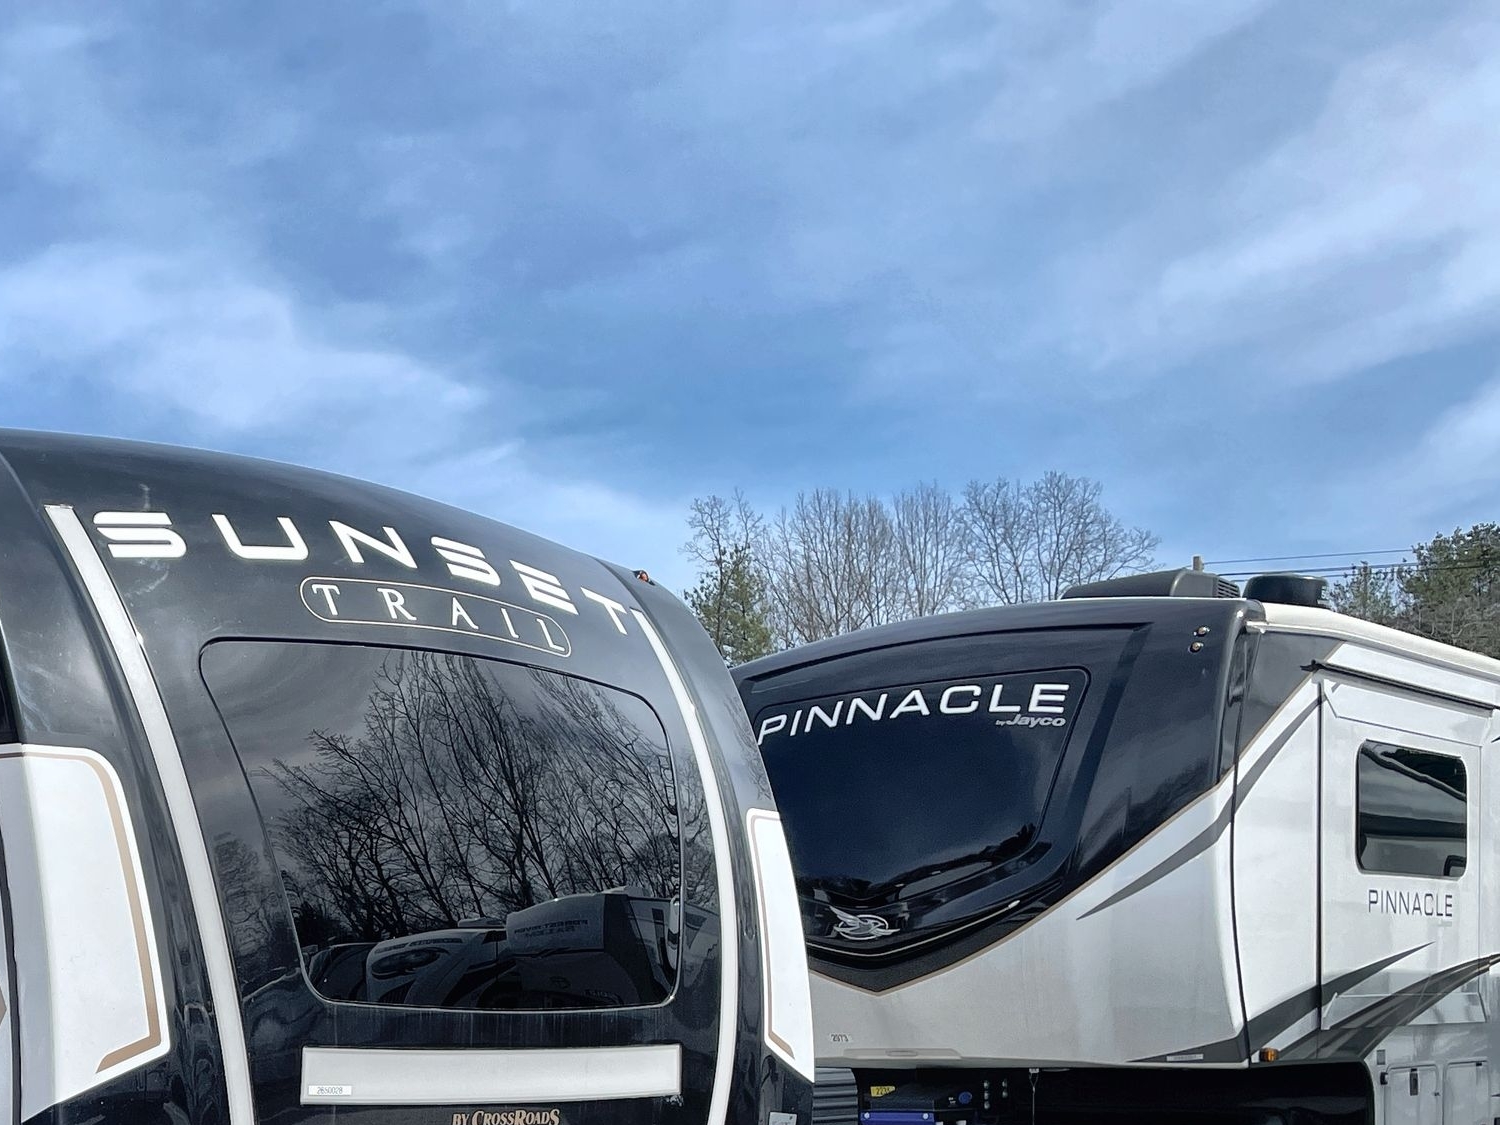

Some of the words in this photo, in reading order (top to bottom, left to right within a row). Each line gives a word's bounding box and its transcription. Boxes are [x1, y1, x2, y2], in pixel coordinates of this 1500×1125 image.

[92, 510, 627, 636] SUNSET
[311, 583, 567, 651] TRAIL
[757, 683, 1070, 746] PINNACLE
[1006, 713, 1066, 728] Jayco
[1368, 889, 1453, 917] PINNACLE
